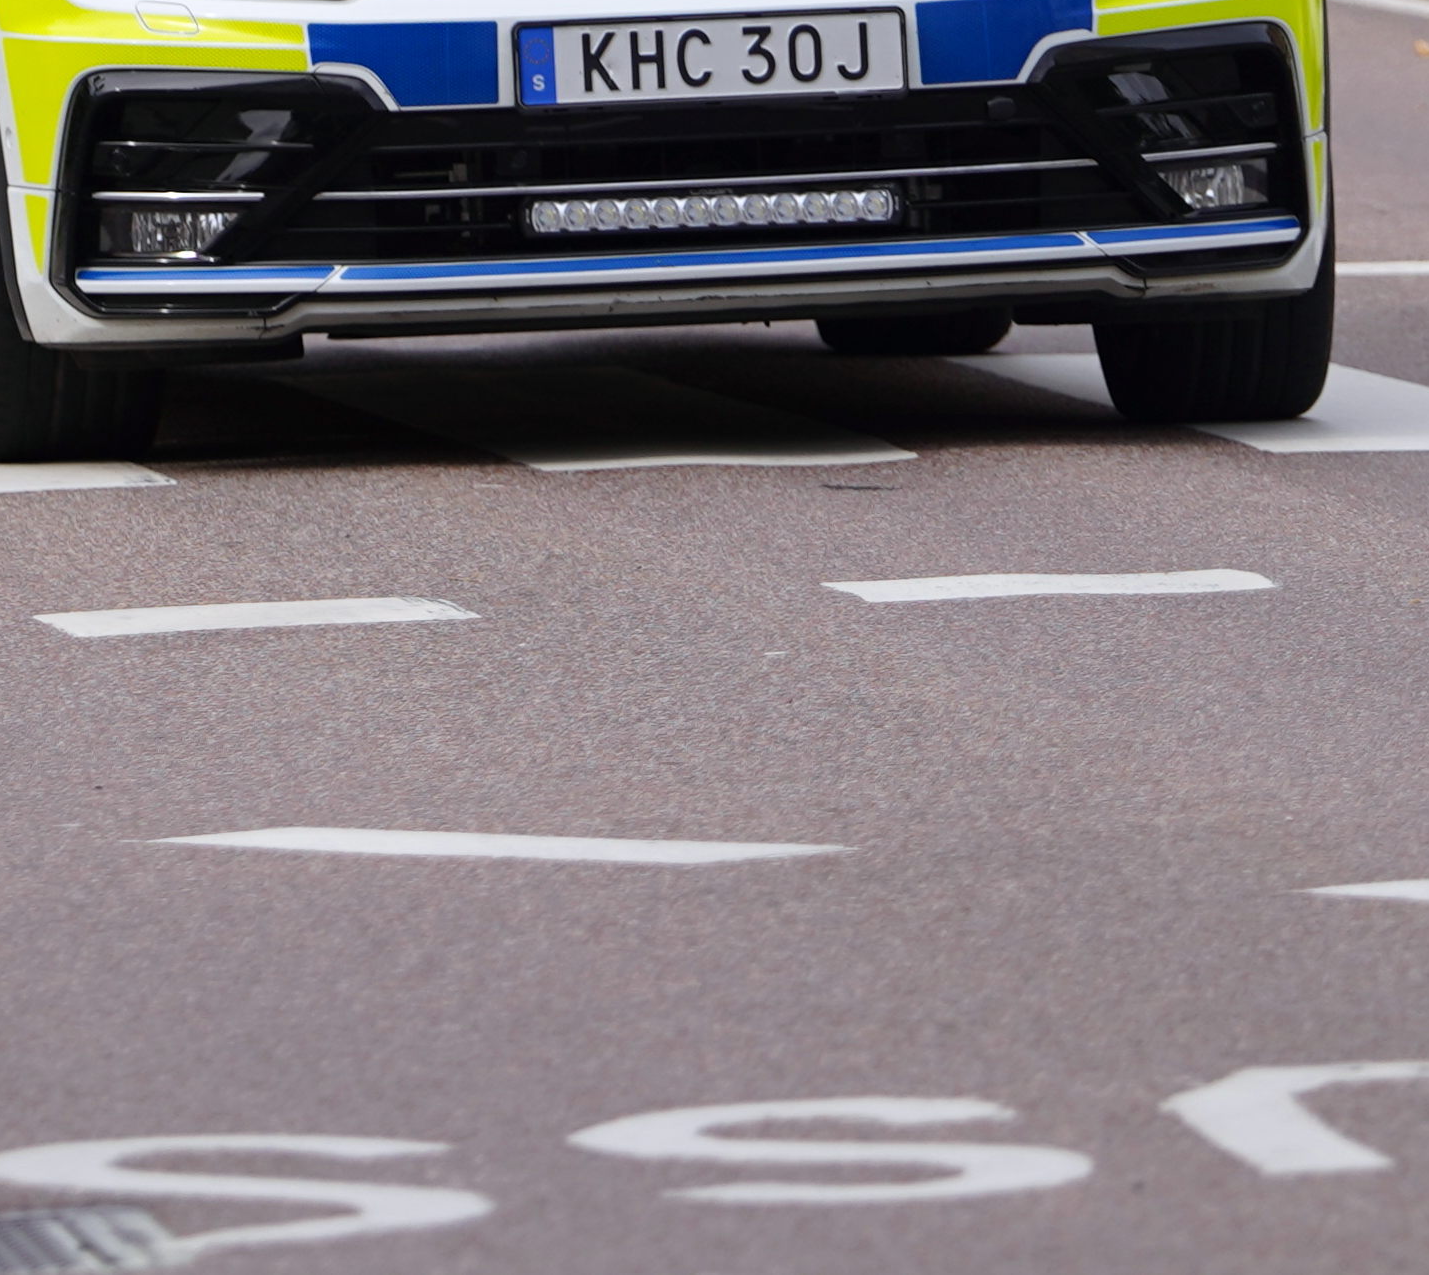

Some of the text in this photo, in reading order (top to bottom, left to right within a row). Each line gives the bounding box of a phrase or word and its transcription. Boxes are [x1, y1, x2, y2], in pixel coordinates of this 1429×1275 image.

[580, 21, 869, 93] KHC 30J
[531, 74, 546, 91] S
